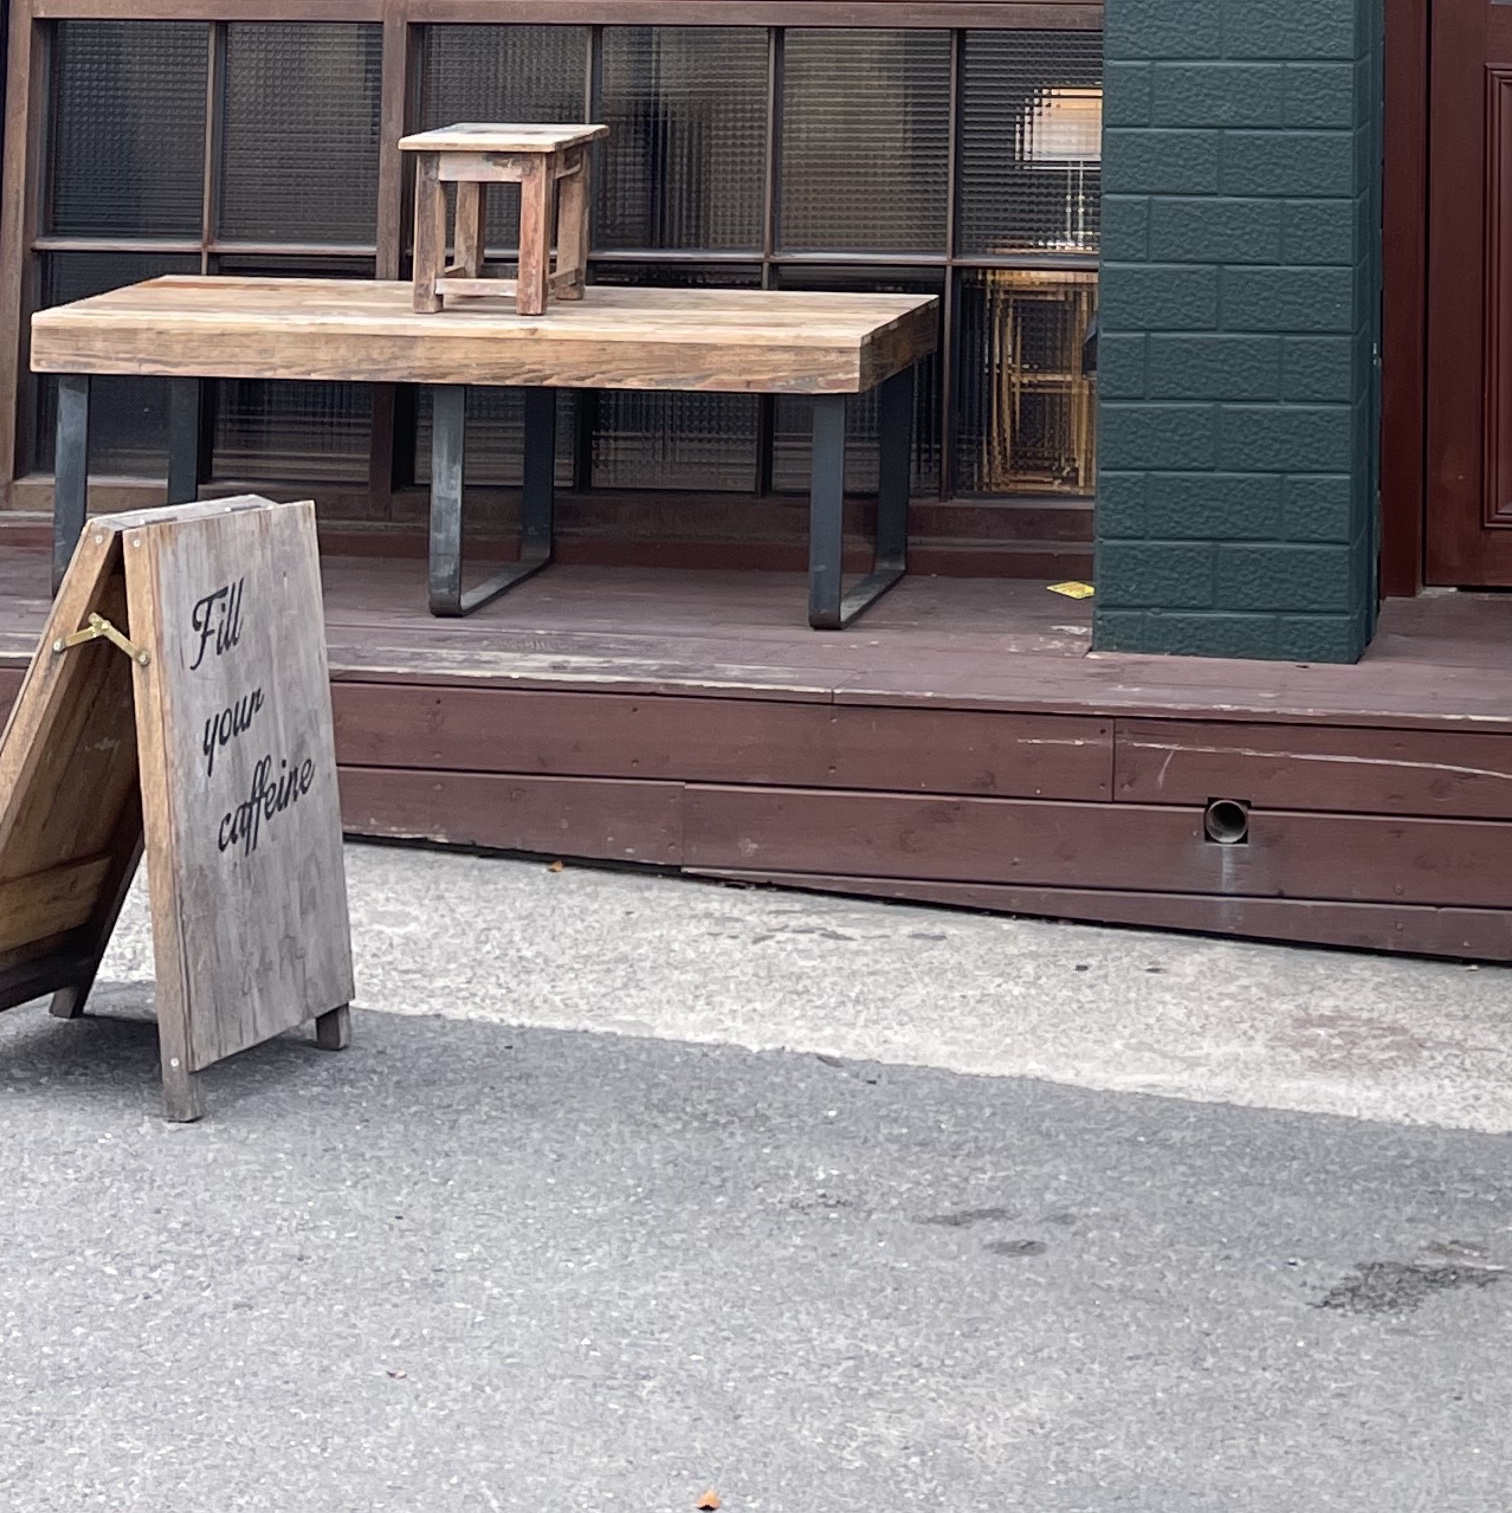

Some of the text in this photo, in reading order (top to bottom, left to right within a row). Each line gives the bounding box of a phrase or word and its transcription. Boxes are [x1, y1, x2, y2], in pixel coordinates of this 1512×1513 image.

[189, 576, 245, 672] Fill
[202, 687, 265, 778] your
[217, 754, 315, 858] caffeine
